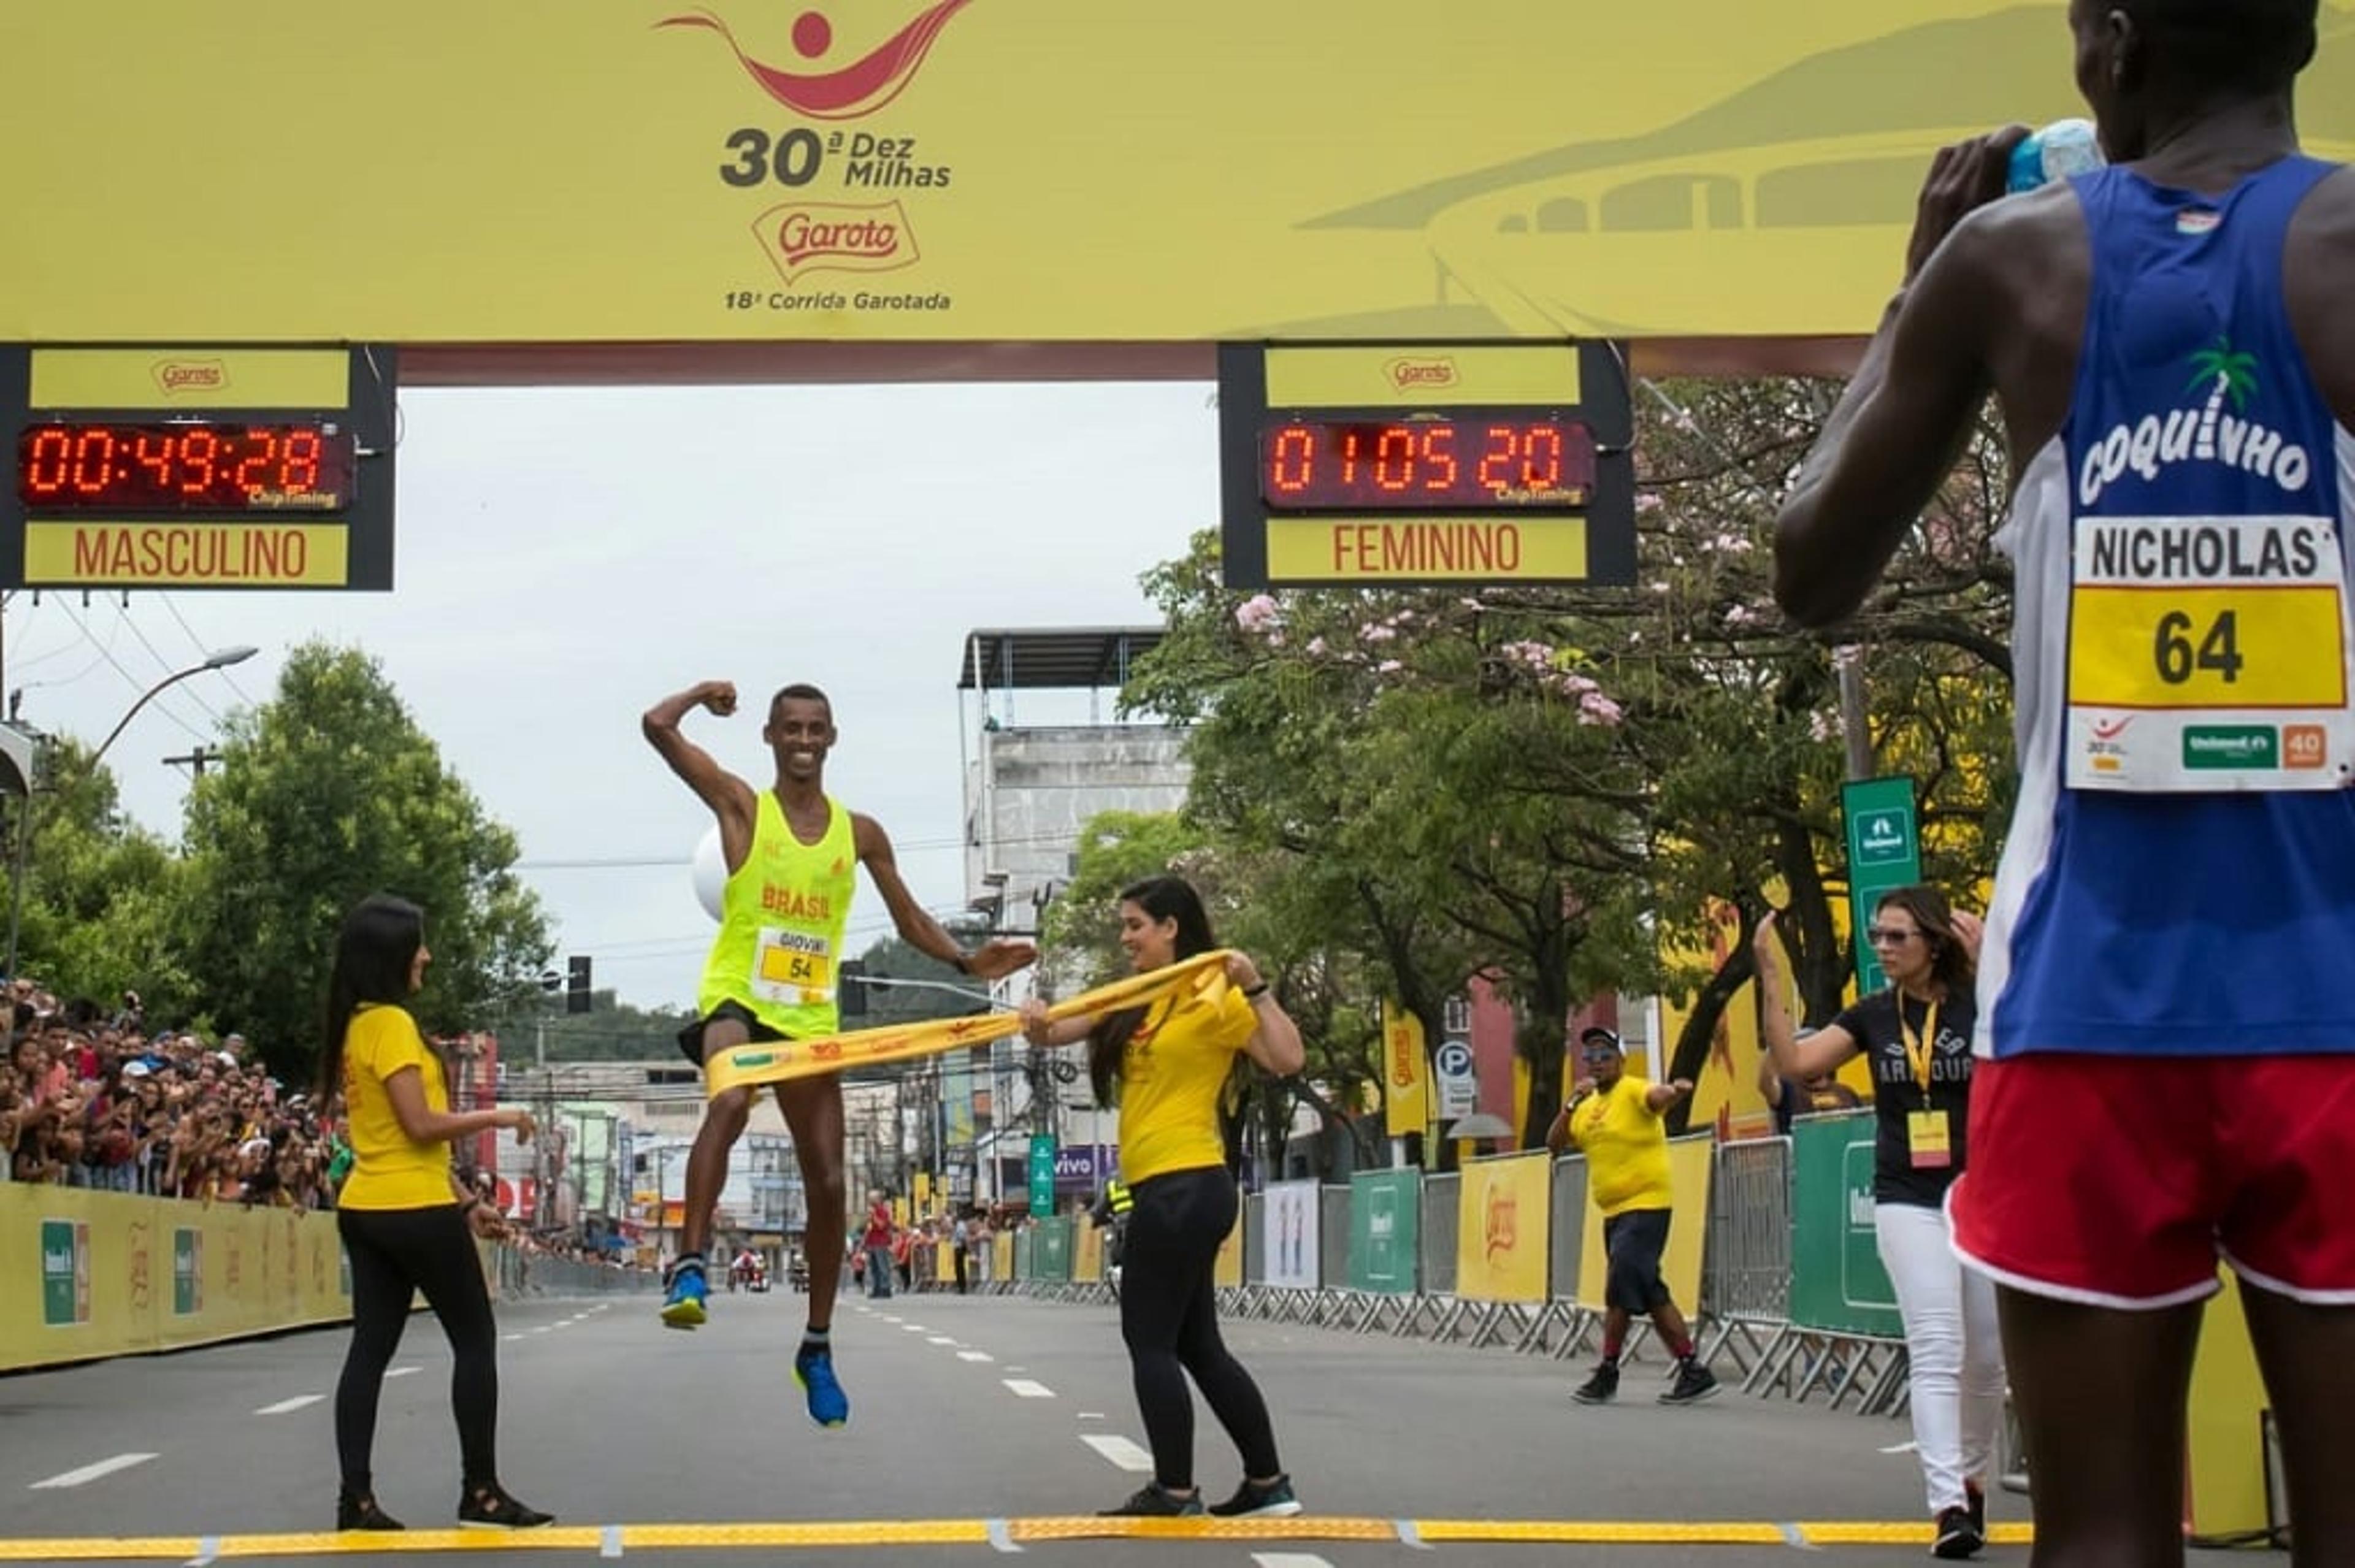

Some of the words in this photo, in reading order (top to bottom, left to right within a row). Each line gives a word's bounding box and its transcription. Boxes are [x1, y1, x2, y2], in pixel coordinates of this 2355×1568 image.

[850, 132, 915, 159] Dez
[844, 161, 951, 188] Milhas
[779, 212, 898, 262] Garoto
[768, 293, 846, 310] Corrida
[853, 293, 951, 310] Garotada
[29, 430, 321, 491] 00:49:28
[2080, 372, 2308, 506] COQUINHO
[75, 528, 306, 576] MASCULINO
[1333, 524, 1520, 572] FEMININO
[2091, 526, 2318, 578] NICHOLAS
[2154, 610, 2243, 684] 64
[791, 958, 810, 979] 54
[1879, 1057, 1973, 1083] AROUR
[1054, 1153, 1092, 1174] vivo
